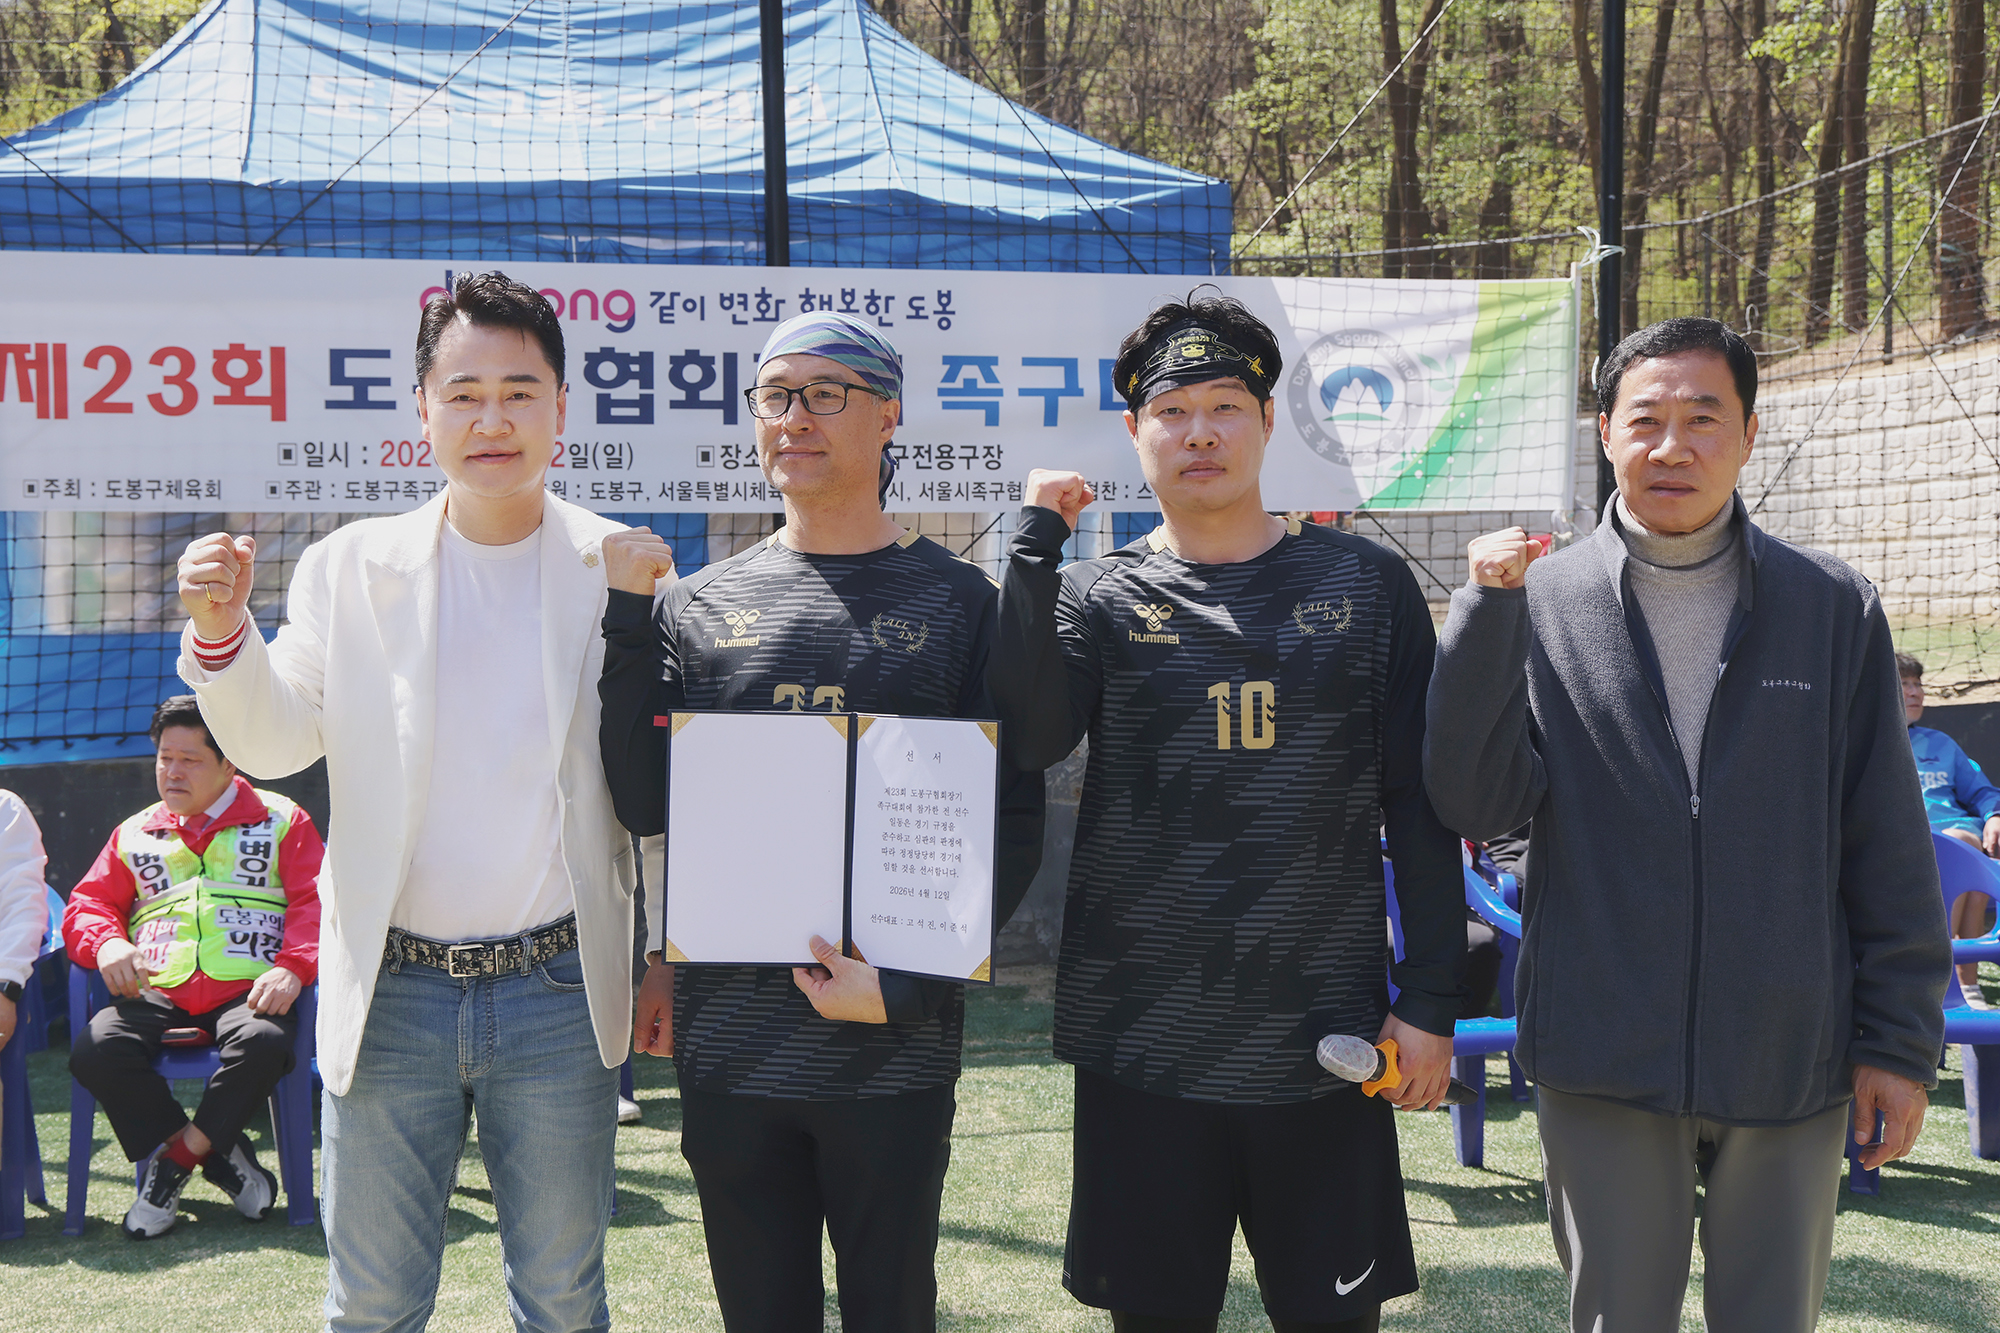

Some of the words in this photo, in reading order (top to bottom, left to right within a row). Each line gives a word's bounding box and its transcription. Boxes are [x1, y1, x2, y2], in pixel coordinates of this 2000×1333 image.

[649, 291, 705, 324] 같이
[719, 286, 786, 325] 변화
[906, 289, 956, 331] 도봉
[1334, 332, 1379, 347] Sports
[0, 342, 287, 422] 제23회
[304, 441, 349, 468] 일시
[362, 445, 369, 465] :
[380, 440, 432, 468] 202
[551, 441, 634, 470] 2일(일)
[893, 443, 1004, 471] 구전용구장
[43, 478, 81, 500] 주최
[91, 481, 96, 497] :
[105, 478, 222, 500] 도봉구체육회
[285, 480, 322, 501] 주관
[331, 482, 336, 498] :
[546, 480, 568, 501] 원
[576, 483, 581, 499] :
[589, 480, 650, 503] 도봉구,
[659, 480, 784, 502] 서울특별시체육
[888, 481, 911, 502] 시,
[918, 480, 1025, 502] 서울시족구협
[1125, 484, 1129, 498] :
[1137, 482, 1157, 500] 스
[1304, 601, 1332, 613] ALL
[882, 618, 911, 630] ALL
[1322, 611, 1342, 621] IN
[714, 634, 761, 649] hummel
[898, 630, 918, 642] IN
[1128, 629, 1180, 645] hummel
[1207, 680, 1276, 750] 10
[905, 750, 914, 762] 선
[932, 751, 941, 764] 서
[884, 786, 907, 797] 제23회
[910, 789, 963, 801] 도봉구협회장기
[877, 801, 912, 813] 족구대회에
[917, 804, 939, 815] 참가한
[942, 806, 950, 816] 전
[953, 807, 969, 817] 선수
[889, 817, 911, 828] 일동은
[915, 819, 929, 830] 경기
[933, 821, 956, 832] 규정을
[881, 831, 911, 843] 준수하고
[914, 834, 936, 845] 심판의
[940, 836, 962, 848] 판정에
[881, 847, 896, 857] 따라
[899, 848, 936, 861] 정정당당히
[940, 852, 962, 863] 경기에
[883, 862, 898, 872] 임할
[901, 864, 916, 874] 것을
[920, 865, 959, 878] 선서합니다.
[889, 886, 915, 897] 2026년
[918, 888, 930, 899] 4월
[934, 890, 950, 901] 12일
[219, 908, 285, 932] 도봉구의
[870, 913, 898, 926] 선수대표
[939, 921, 947, 932] 이
[960, 924, 968, 934] 석
